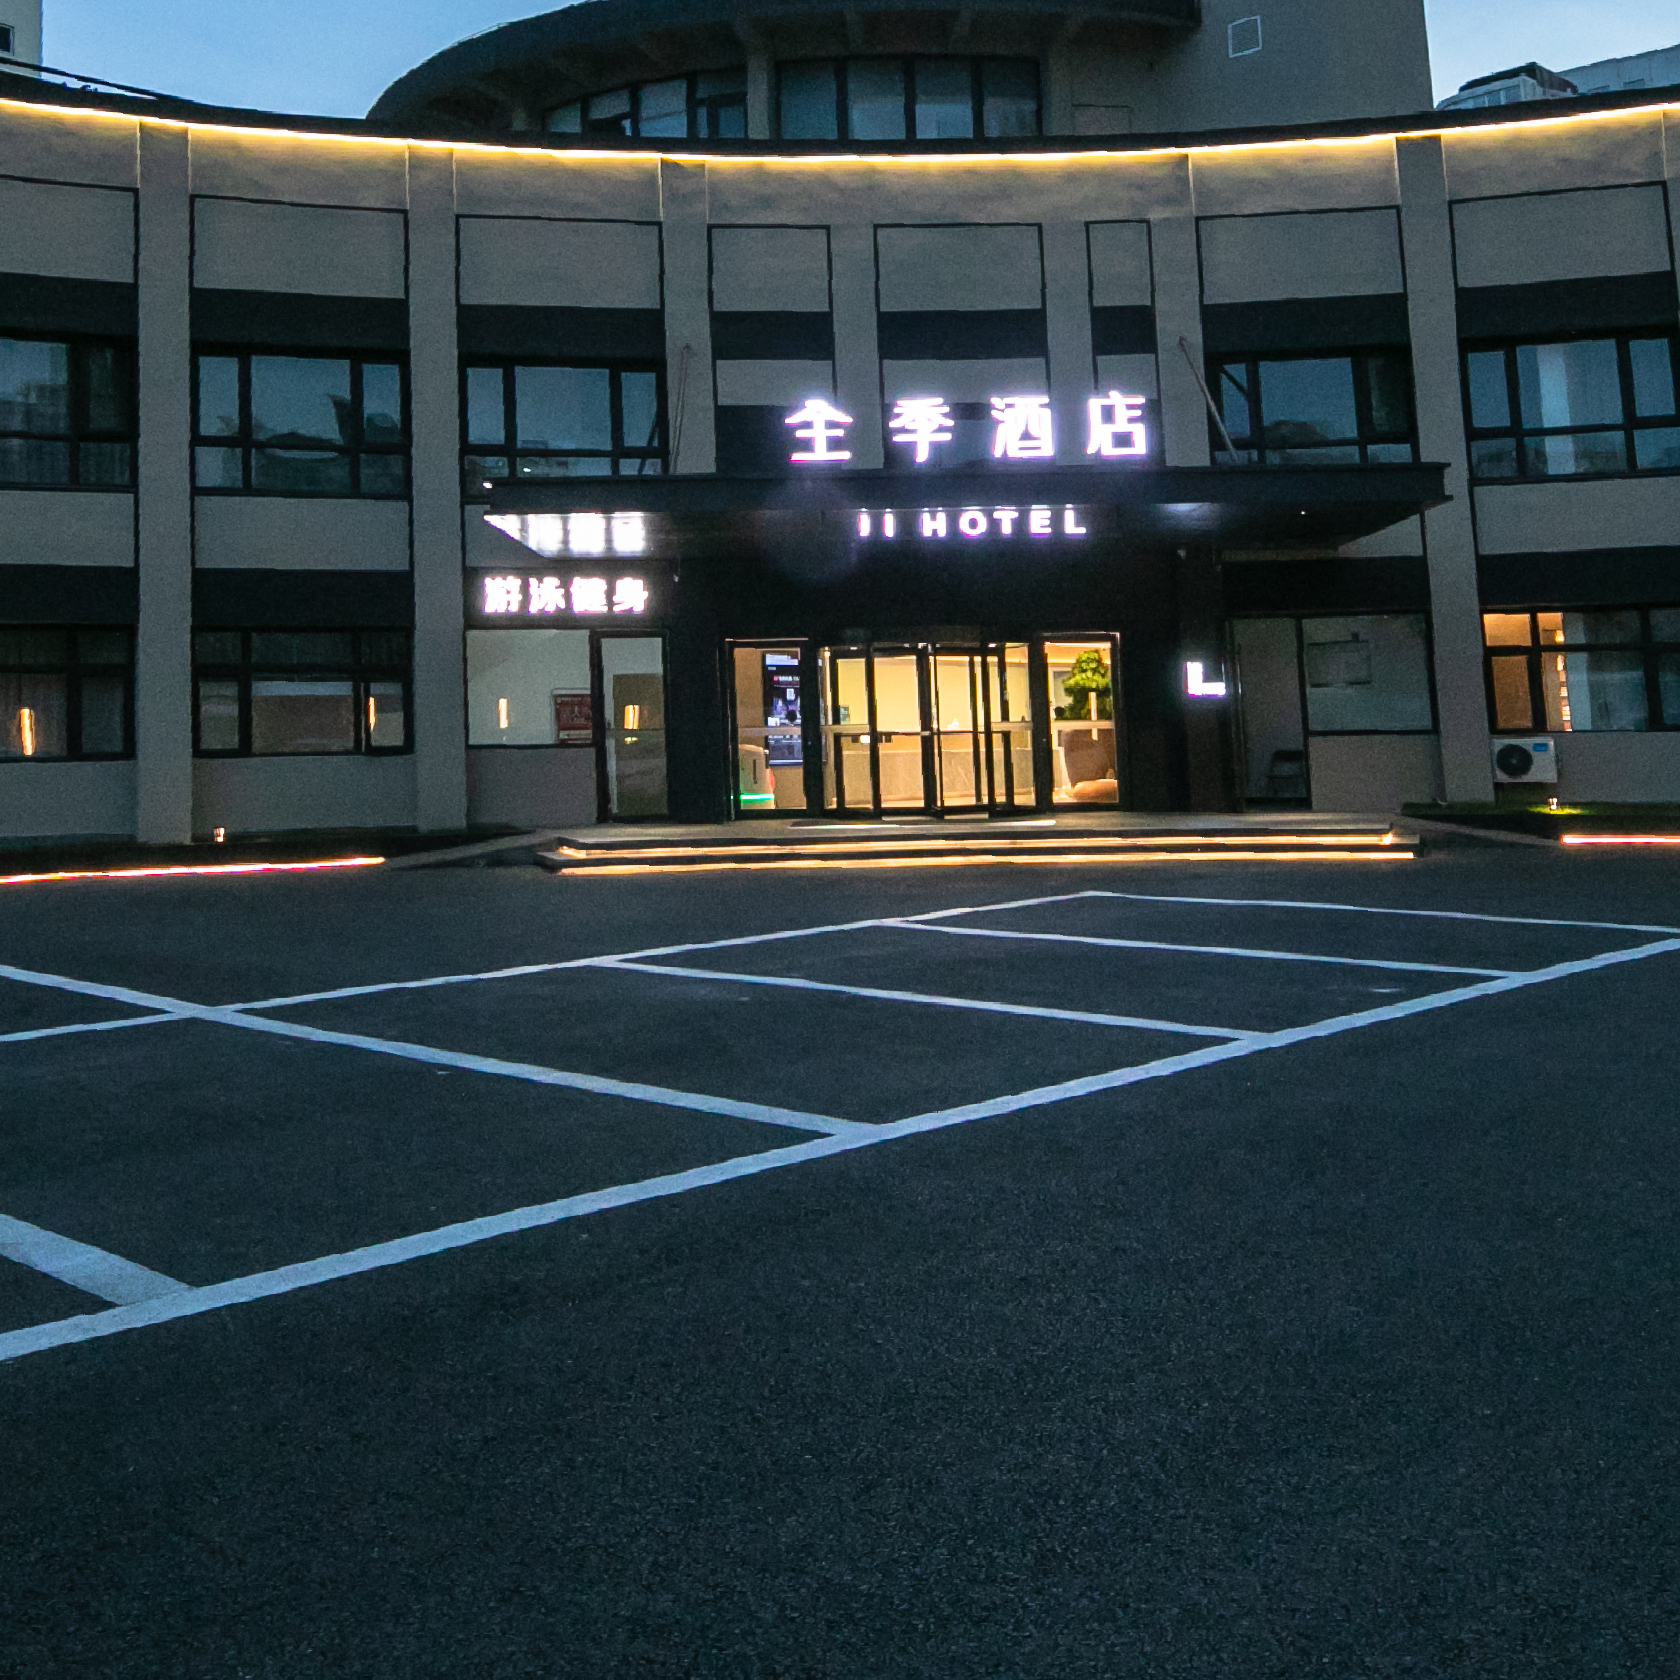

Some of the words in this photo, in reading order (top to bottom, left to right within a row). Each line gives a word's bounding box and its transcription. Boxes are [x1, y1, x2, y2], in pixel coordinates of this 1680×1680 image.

[784, 390, 1148, 463] 全季酒店
[921, 510, 1088, 537] HOTEL
[484, 575, 649, 614] 游泳健身
